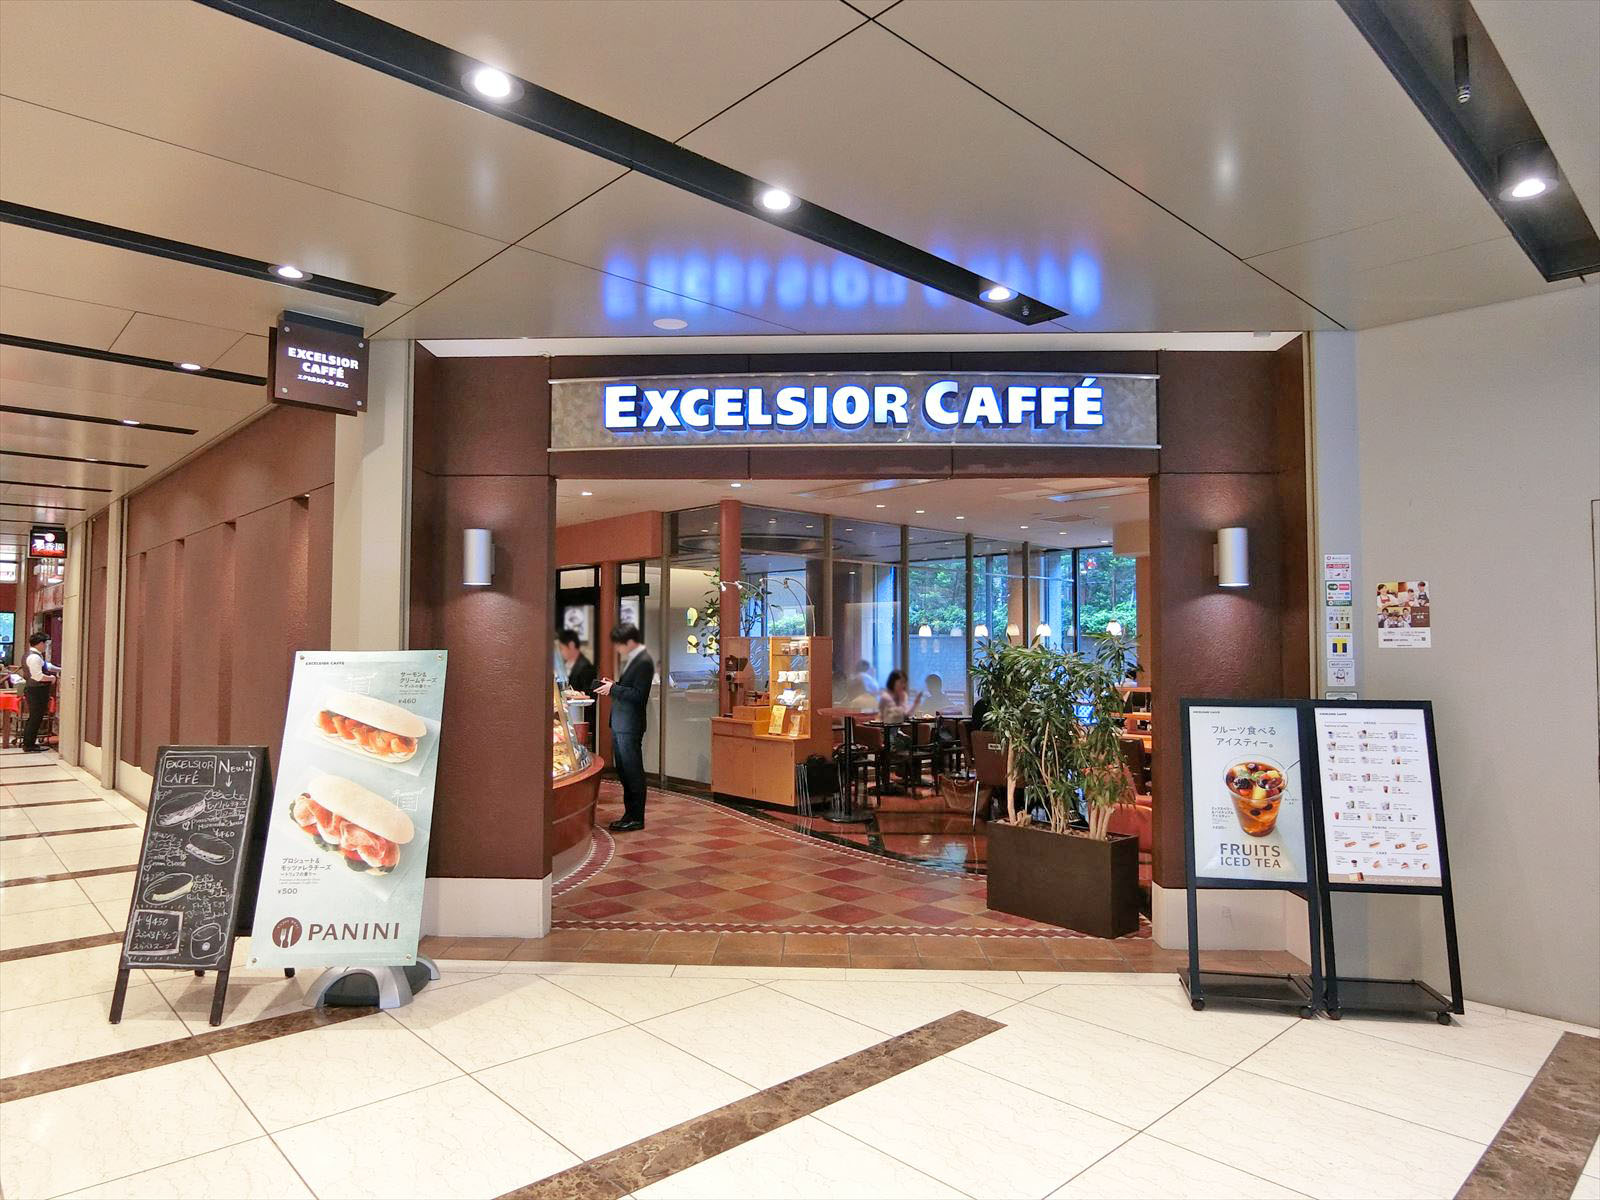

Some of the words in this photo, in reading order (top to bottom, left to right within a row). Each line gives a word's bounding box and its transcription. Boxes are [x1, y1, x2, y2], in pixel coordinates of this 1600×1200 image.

[288, 346, 359, 370] EXCELSIOR
[302, 361, 345, 379] CAFFÉ
[604, 385, 909, 429] EXCELSIOR
[924, 377, 1105, 429] CAFFÉ
[1211, 726, 1277, 736] フルーツ食べる
[165, 759, 214, 770] EXCELSIOR
[164, 770, 199, 785] CAFFÉ
[1220, 843, 1281, 857] FRUITS
[1220, 856, 1251, 867] ICED
[1254, 857, 1282, 868] TEA
[308, 922, 400, 941] PANINI
